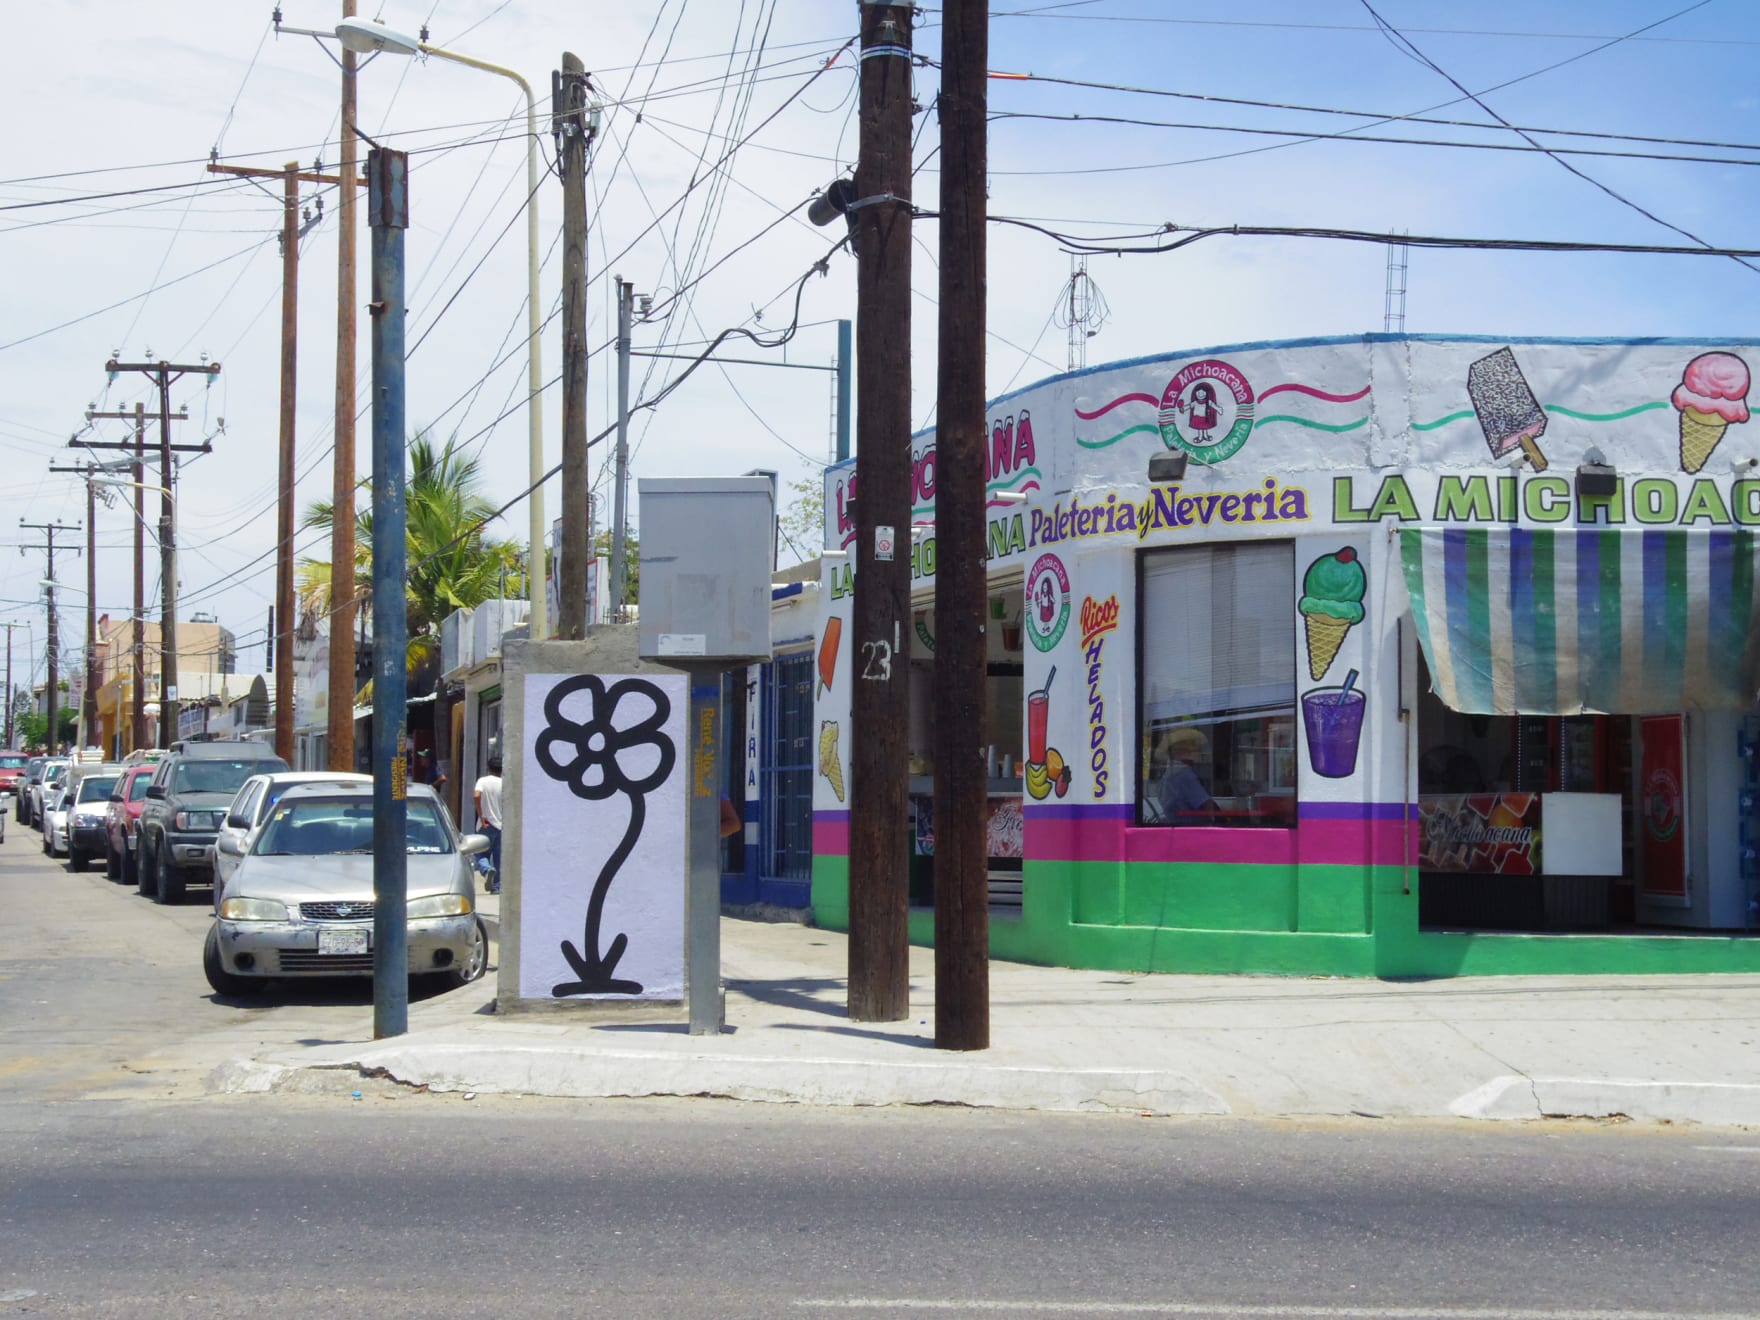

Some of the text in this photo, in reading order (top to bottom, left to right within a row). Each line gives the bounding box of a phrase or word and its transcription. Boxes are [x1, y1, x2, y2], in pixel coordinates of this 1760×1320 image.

[1162, 363, 1248, 407] La Michoacana
[1028, 493, 1138, 548] Paleteria
[1136, 499, 1154, 539] y
[1150, 478, 1309, 529] Neveria
[1332, 474, 1422, 523] LA
[831, 562, 855, 600] LA
[1080, 595, 1119, 635] Ricos
[1085, 638, 1109, 799] HELADOS
